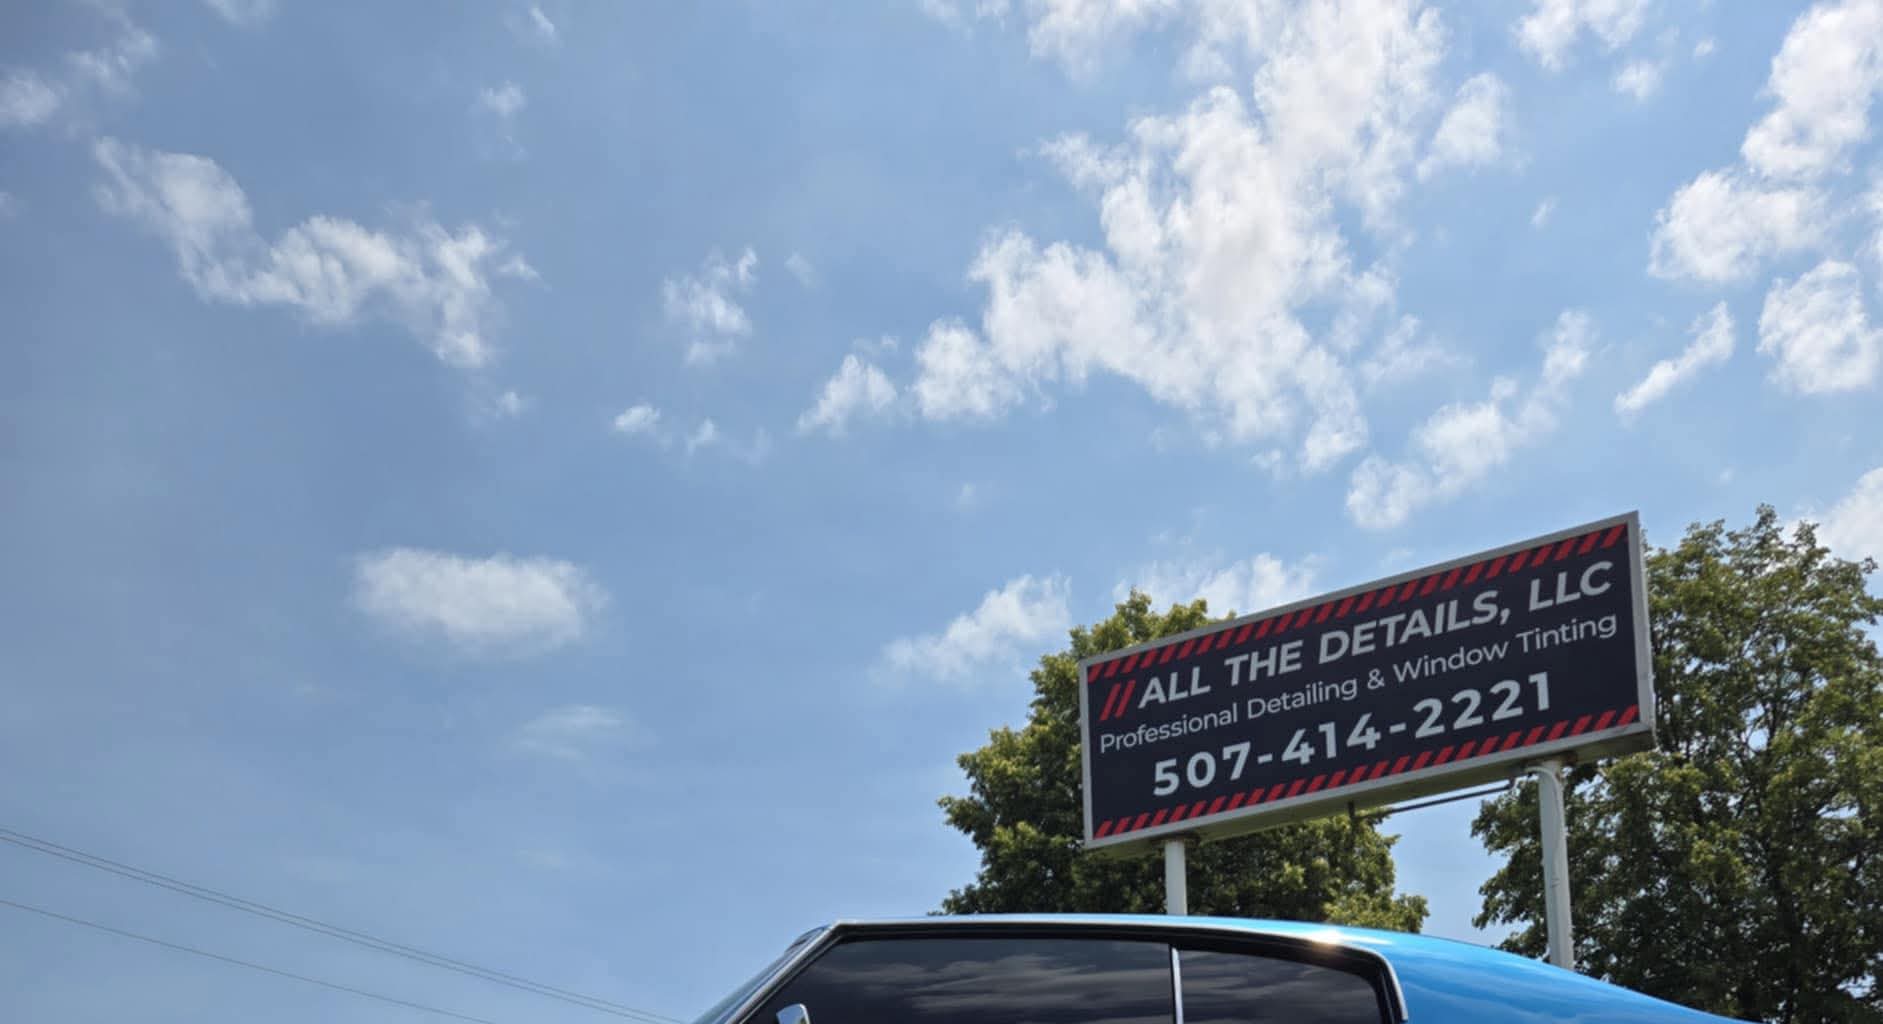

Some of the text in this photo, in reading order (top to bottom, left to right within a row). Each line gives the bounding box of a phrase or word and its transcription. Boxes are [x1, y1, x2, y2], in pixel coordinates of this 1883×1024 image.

[1101, 615, 1616, 753] Professional Detailing & Window Tinting
[1138, 560, 1612, 708] ALL THE DETAILS, LLC
[1154, 672, 1549, 795] 507-414-2221
